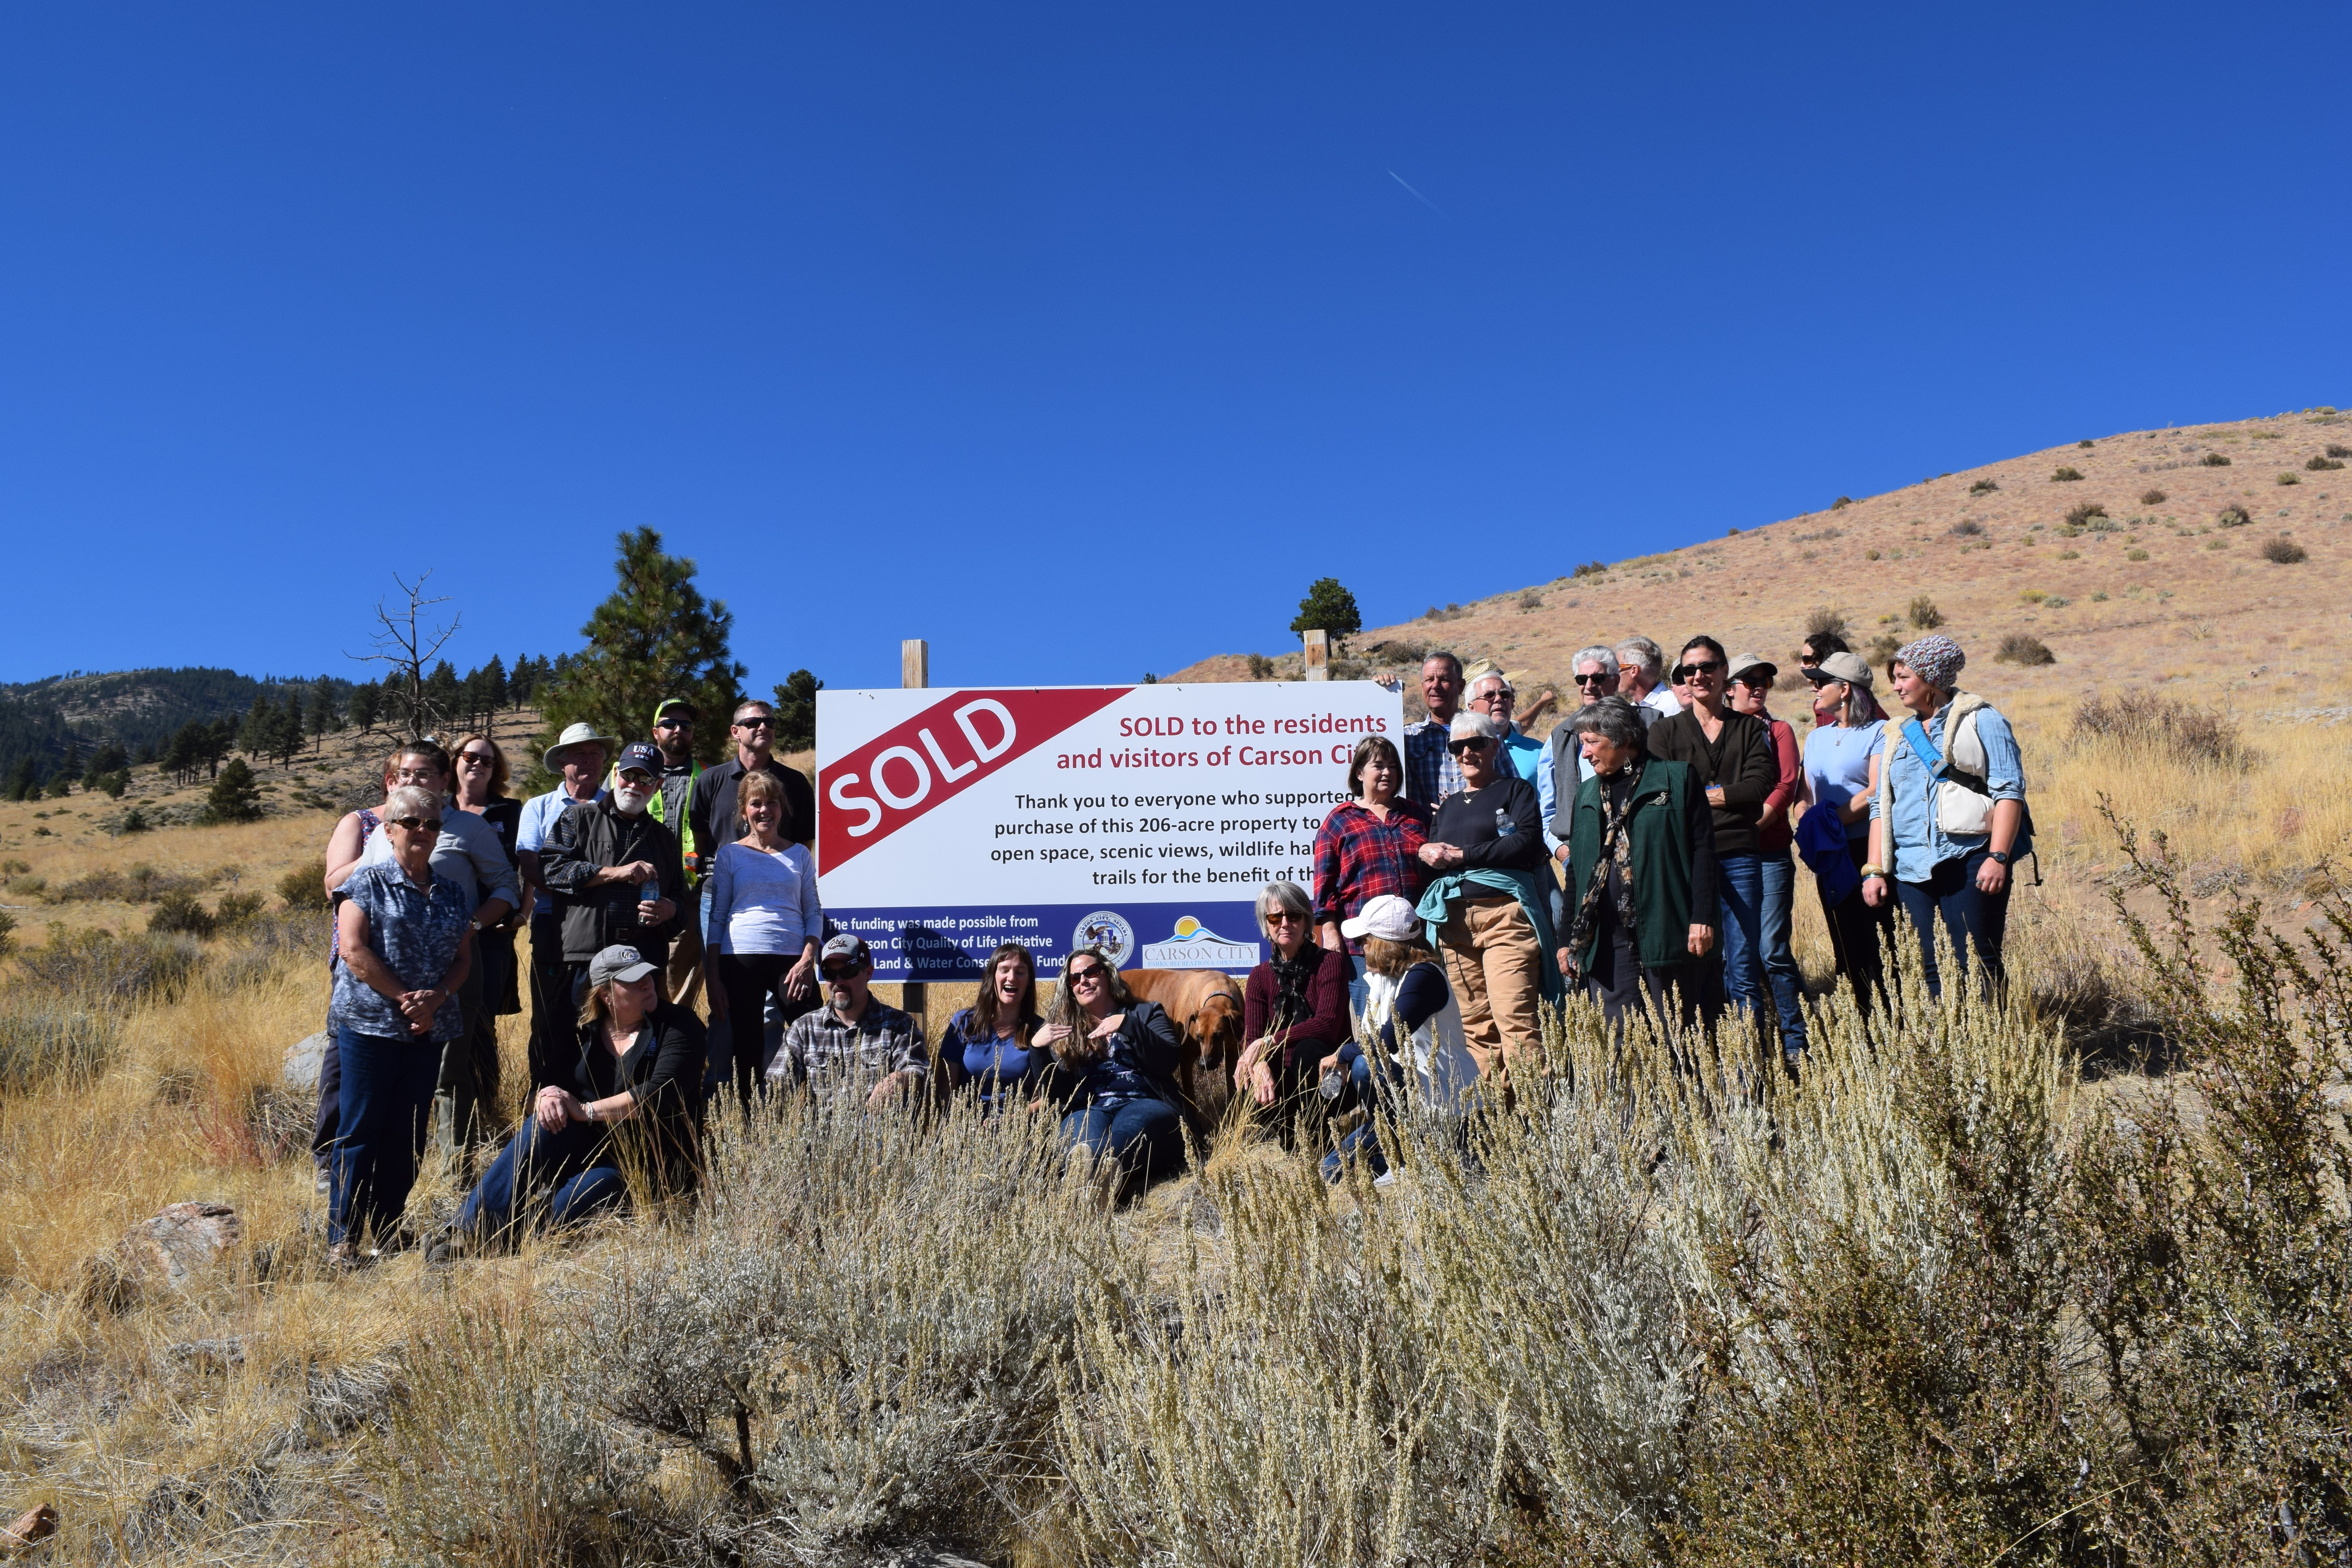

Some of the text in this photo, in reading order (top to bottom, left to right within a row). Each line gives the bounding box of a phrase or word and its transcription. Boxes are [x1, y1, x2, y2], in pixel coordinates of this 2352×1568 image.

[1120, 713, 1386, 737] SOLD to the residents
[633, 745, 654, 756] USA
[1058, 748, 1101, 768] and
[1110, 748, 1198, 768] visitors
[1207, 746, 1231, 766] of
[1239, 747, 1322, 766] Carson
[829, 699, 1016, 837] SOLD
[1015, 794, 1068, 809] Thank
[1074, 797, 1104, 811] you
[1111, 795, 1128, 807] to
[1135, 795, 1216, 809] everyone
[1222, 790, 1259, 805] who
[995, 817, 1320, 838] purchase of this 206-acre property to
[991, 850, 1034, 864] open
[1040, 849, 1094, 863] space,
[1100, 844, 1152, 858] scenic
[1158, 843, 1213, 860] views,
[1219, 841, 1284, 856] wildlife
[1093, 866, 1314, 885] trails for the benefit of th
[827, 915, 1038, 932] The funding was made possible from
[1079, 919, 1093, 937] CARSON
[1113, 919, 1127, 936] NEVADA
[891, 937, 913, 951] City
[916, 936, 958, 951] Quality
[962, 936, 974, 947] of
[977, 935, 997, 947] Life
[1001, 935, 1053, 947] Initiative
[874, 956, 900, 969] Land
[904, 957, 913, 969] &
[917, 957, 953, 968] Water
[1145, 946, 1257, 960] CARSON CITY
